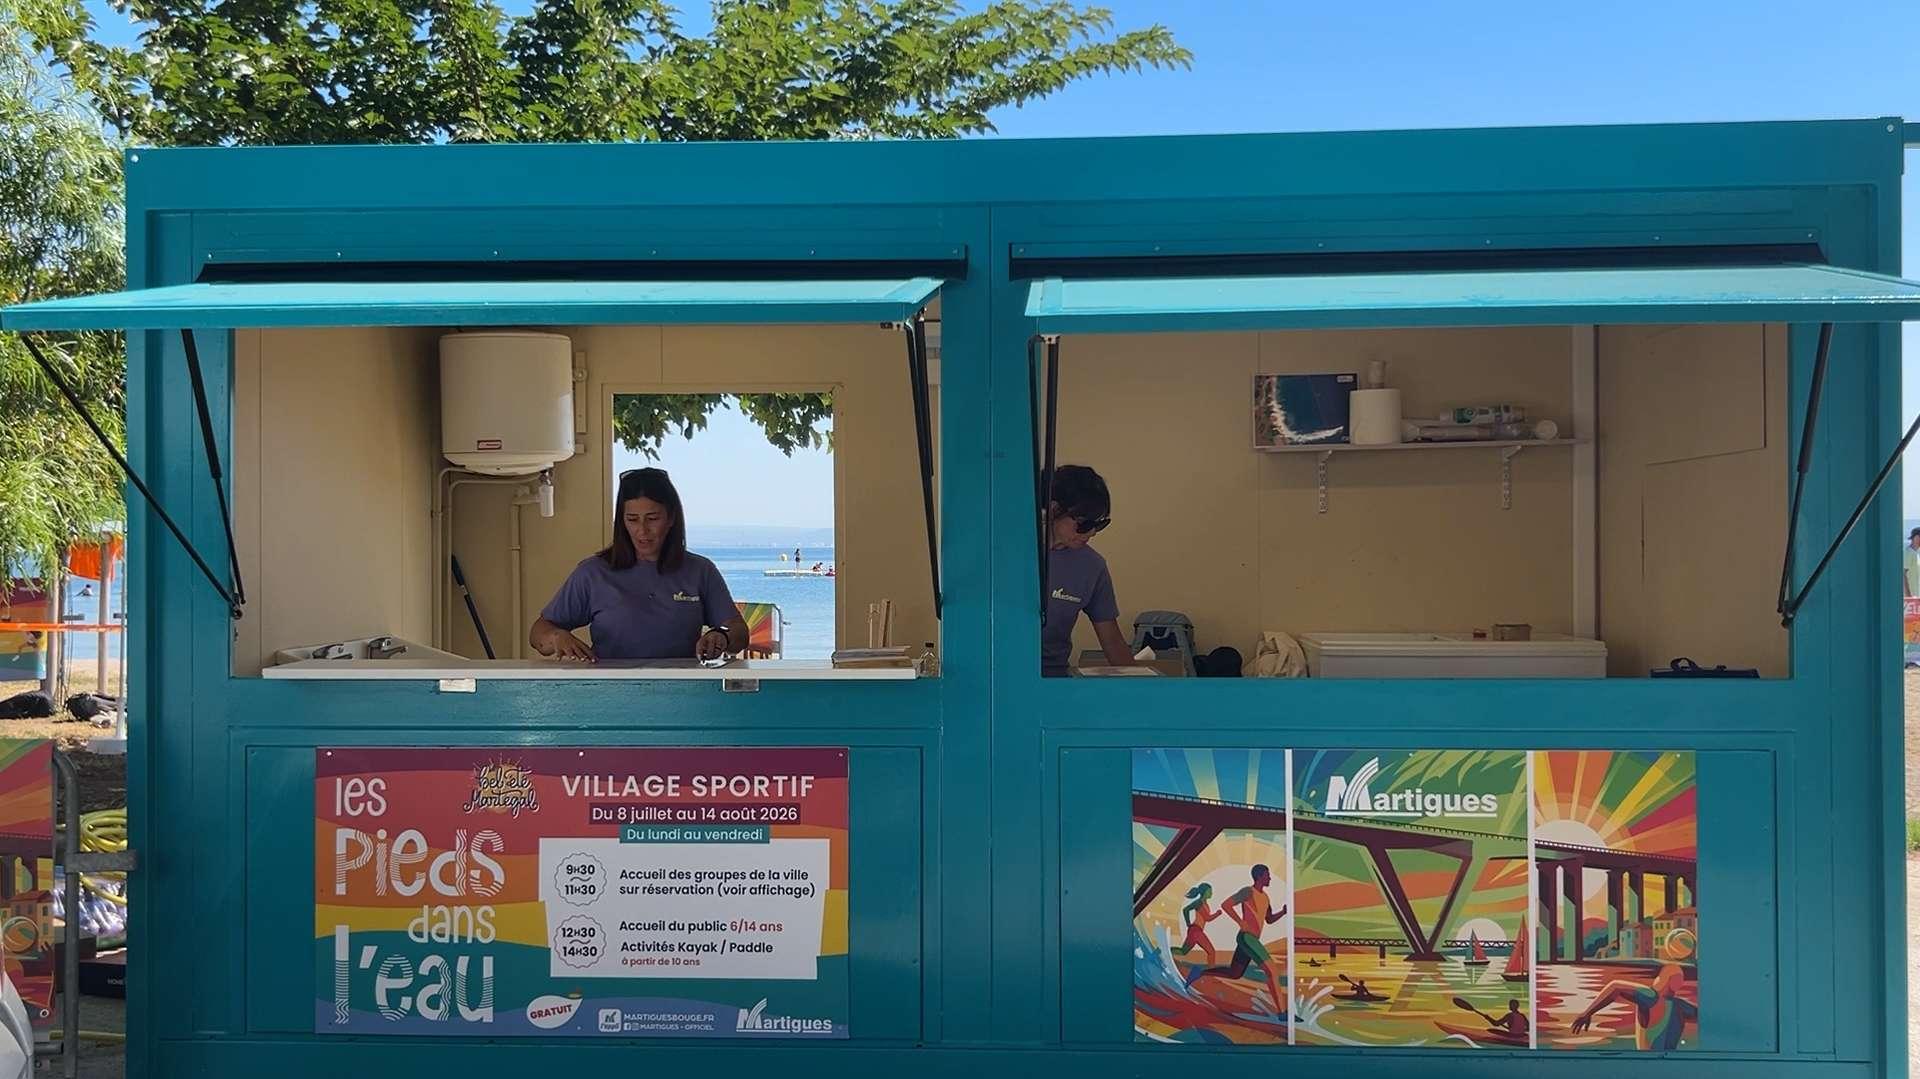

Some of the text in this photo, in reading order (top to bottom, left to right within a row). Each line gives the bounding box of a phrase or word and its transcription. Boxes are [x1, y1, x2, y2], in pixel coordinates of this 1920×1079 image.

[562, 774, 815, 798] VILLAGE SPORTIF
[1325, 756, 1499, 817] Martigues
[335, 777, 388, 817] les
[592, 806, 798, 824] Du 8 juillet au 14 août 2026
[627, 828, 763, 841] Du lundi au vendredi
[335, 828, 506, 897] Pieds
[566, 864, 596, 876] 9H30
[619, 868, 809, 883] Accueil des groupes de la ville
[565, 884, 597, 895] 11H30
[619, 882, 815, 898] sur réservation (voir affichage)
[408, 904, 496, 944] dans
[619, 918, 783, 934] Accueil du public 6/14 ans
[561, 927, 596, 938] 12H30
[562, 946, 598, 957] 14H30
[620, 938, 774, 956] Activités Kayak / Paddle
[630, 957, 656, 967] partir
[657, 958, 671, 966] de
[671, 957, 681, 966] 10
[682, 958, 701, 966] ans
[335, 924, 495, 1024] l'eau
[530, 1003, 573, 1019] GRATUIT
[736, 998, 832, 1033] Martigues
